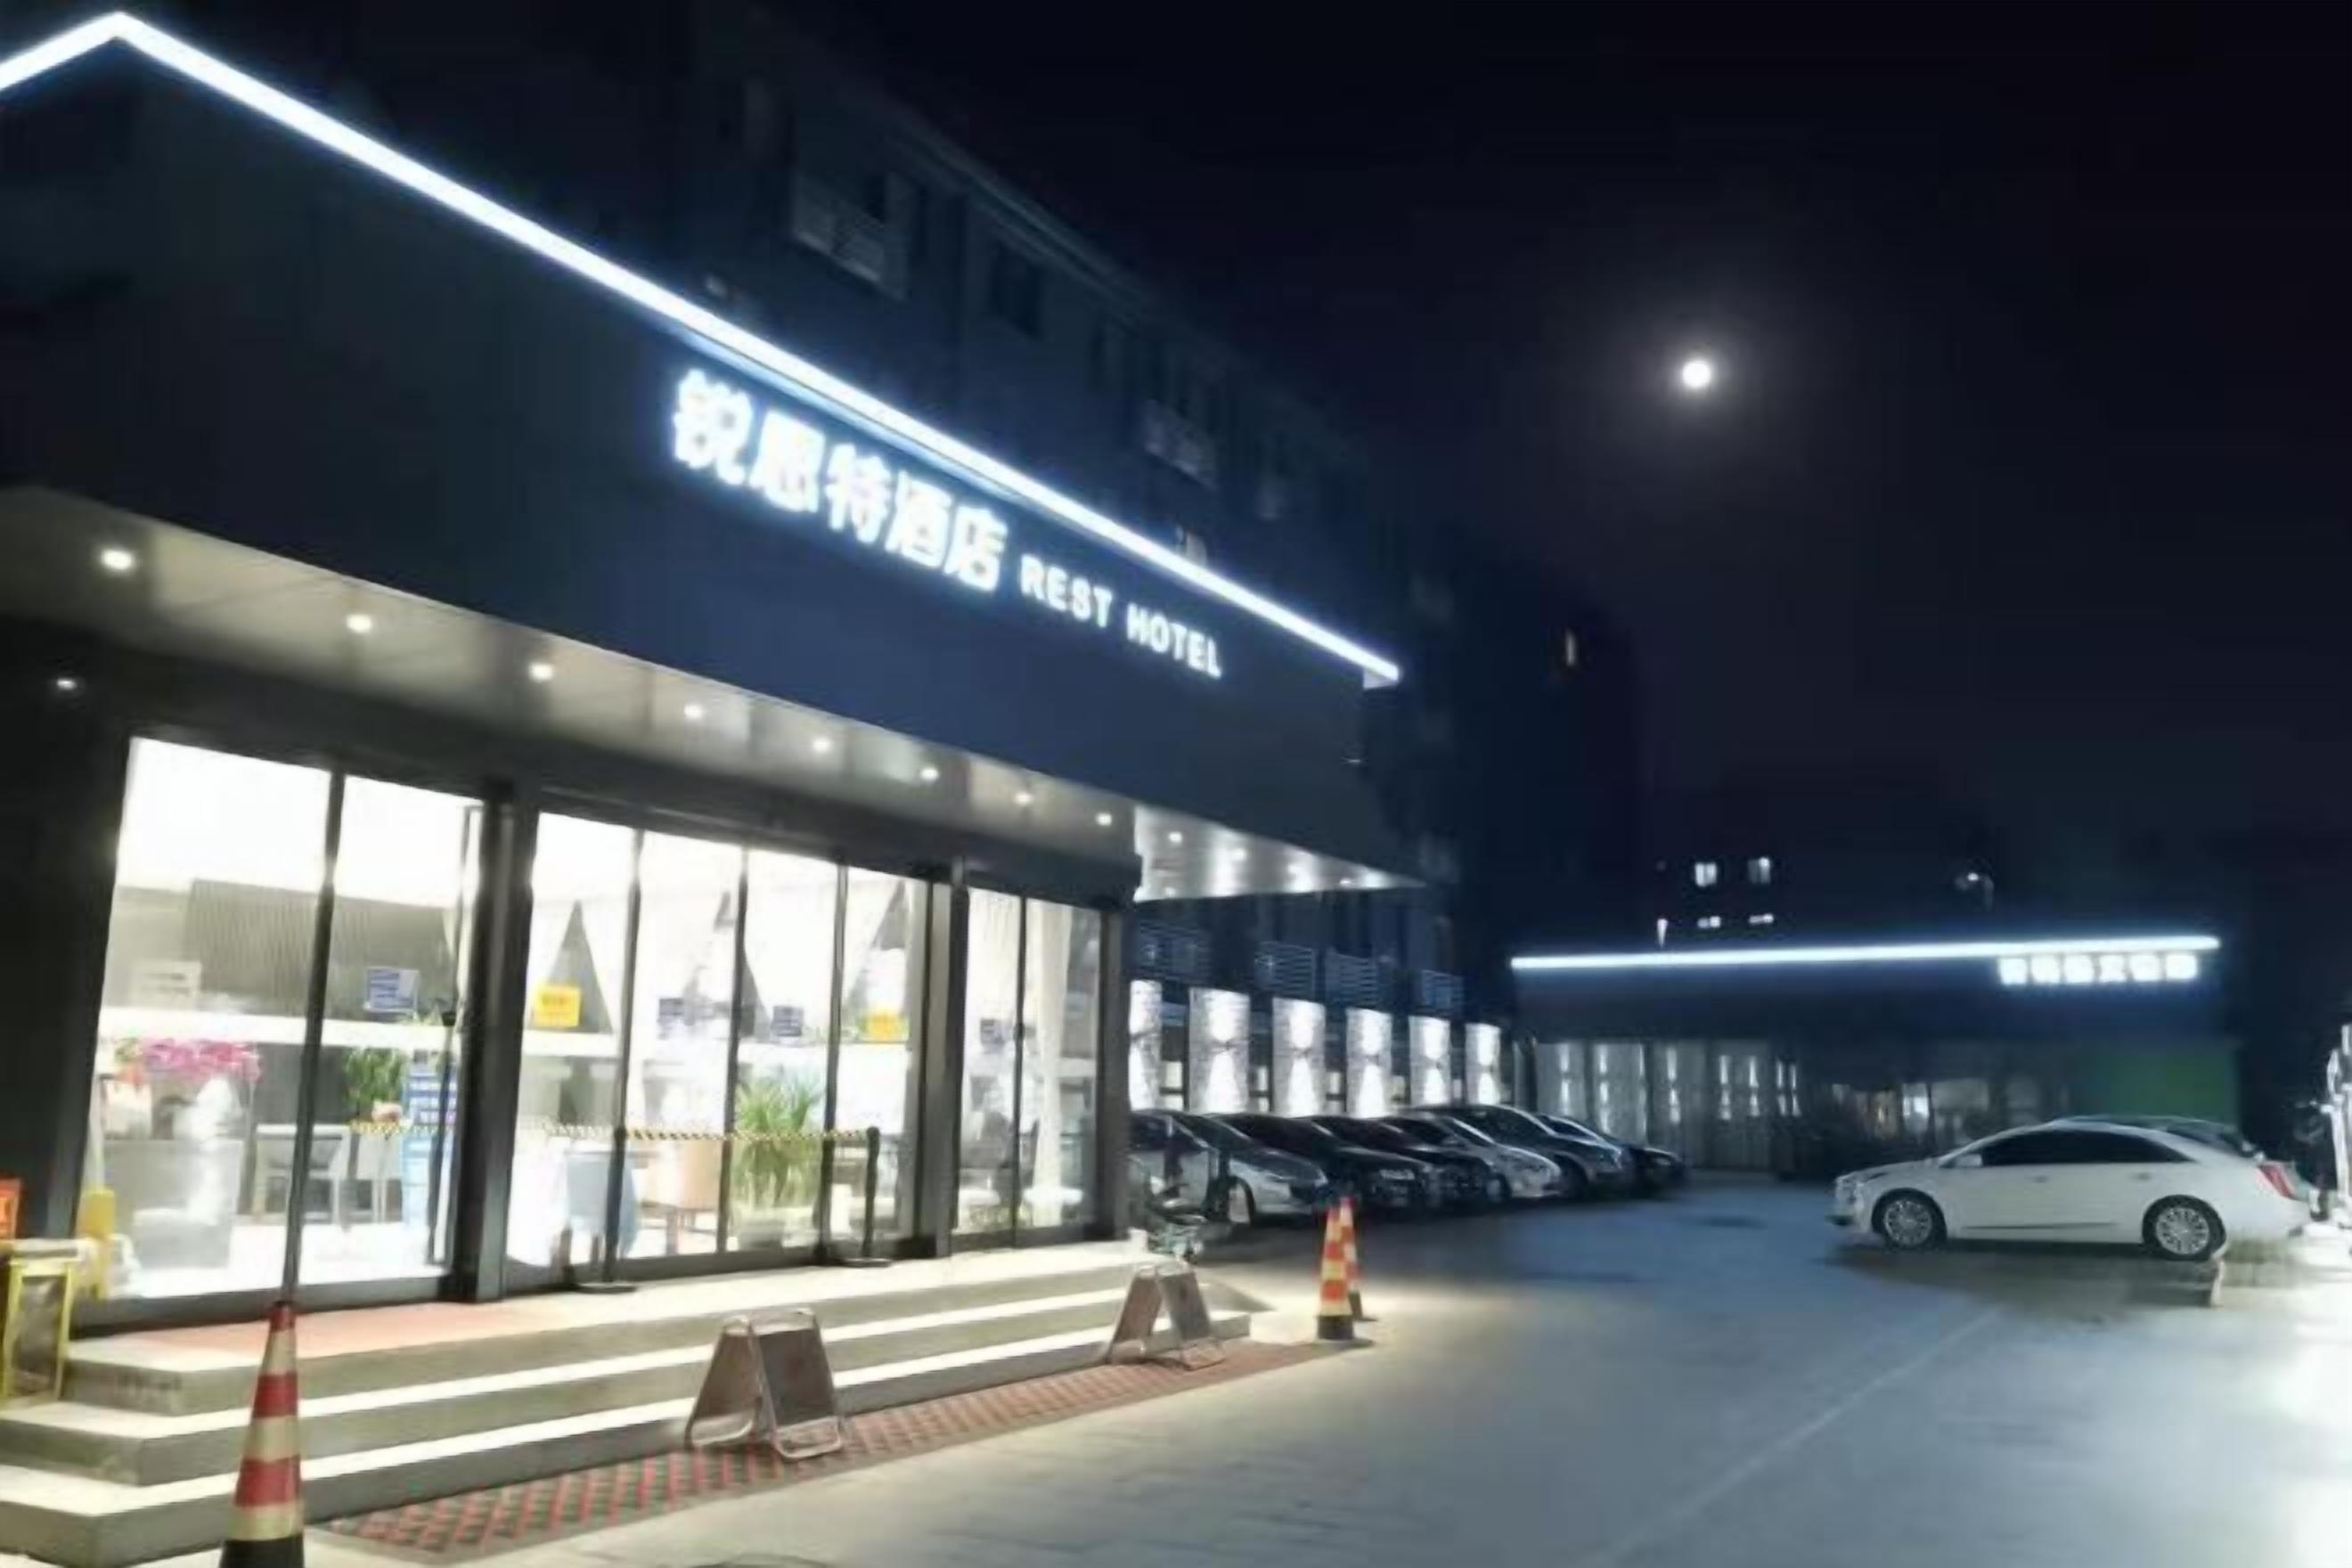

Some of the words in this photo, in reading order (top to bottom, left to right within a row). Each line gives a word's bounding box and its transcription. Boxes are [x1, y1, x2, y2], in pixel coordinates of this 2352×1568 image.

[674, 369, 1008, 592] 锐思特酒店
[1020, 553, 1112, 628] REST
[1126, 601, 1221, 680] HOTEL
